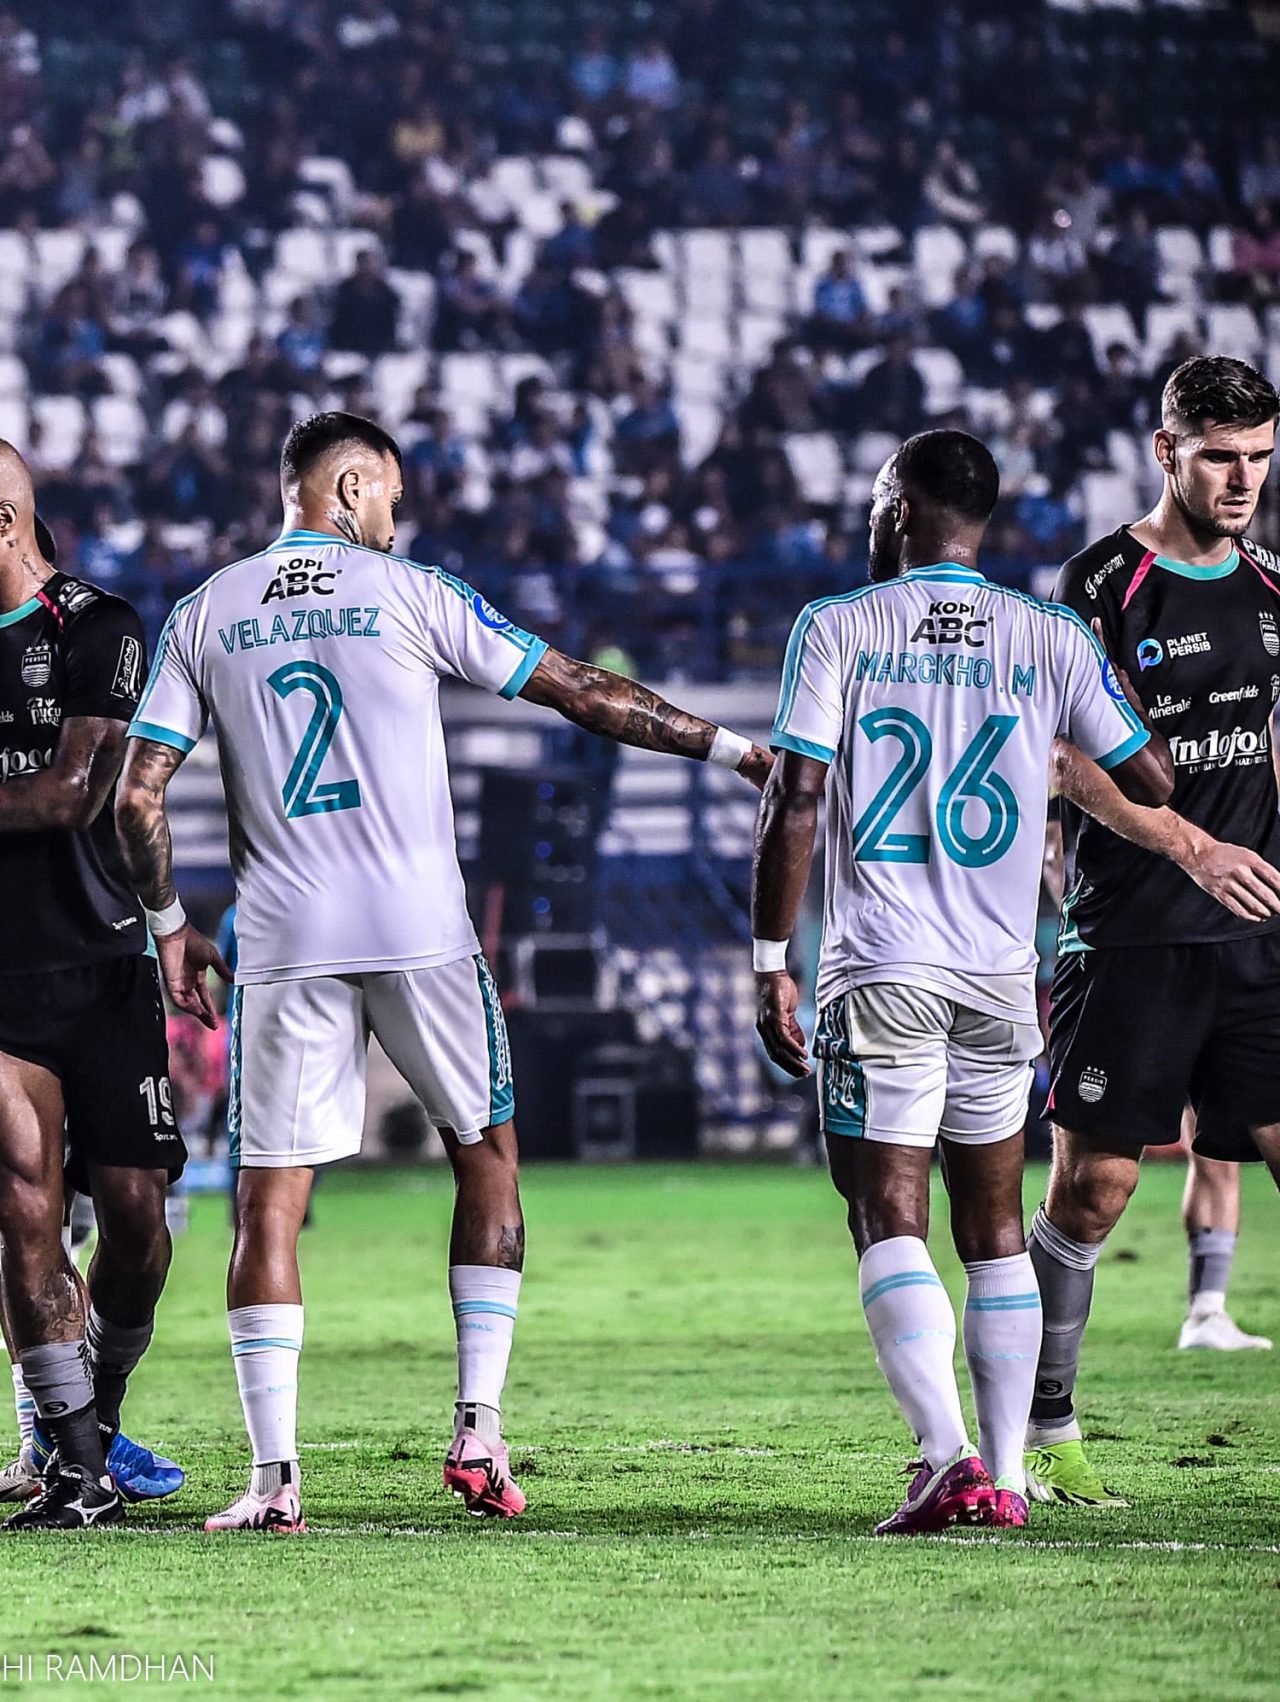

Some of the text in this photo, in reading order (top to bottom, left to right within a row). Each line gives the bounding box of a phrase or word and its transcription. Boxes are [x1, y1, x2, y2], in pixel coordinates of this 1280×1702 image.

[277, 558, 323, 576] KOPI
[260, 570, 336, 605] ABC
[928, 601, 975, 617] KOPI
[218, 607, 380, 655] VELAZQUEZ
[910, 617, 987, 648] ABC
[1166, 632, 1207, 647] PLANET
[1169, 641, 1211, 659] PERSIB
[1156, 695, 1171, 706] Le
[267, 660, 361, 819] 2
[1169, 724, 1267, 768] Indofod
[853, 706, 1020, 869] 26
[139, 1076, 175, 1126] 19
